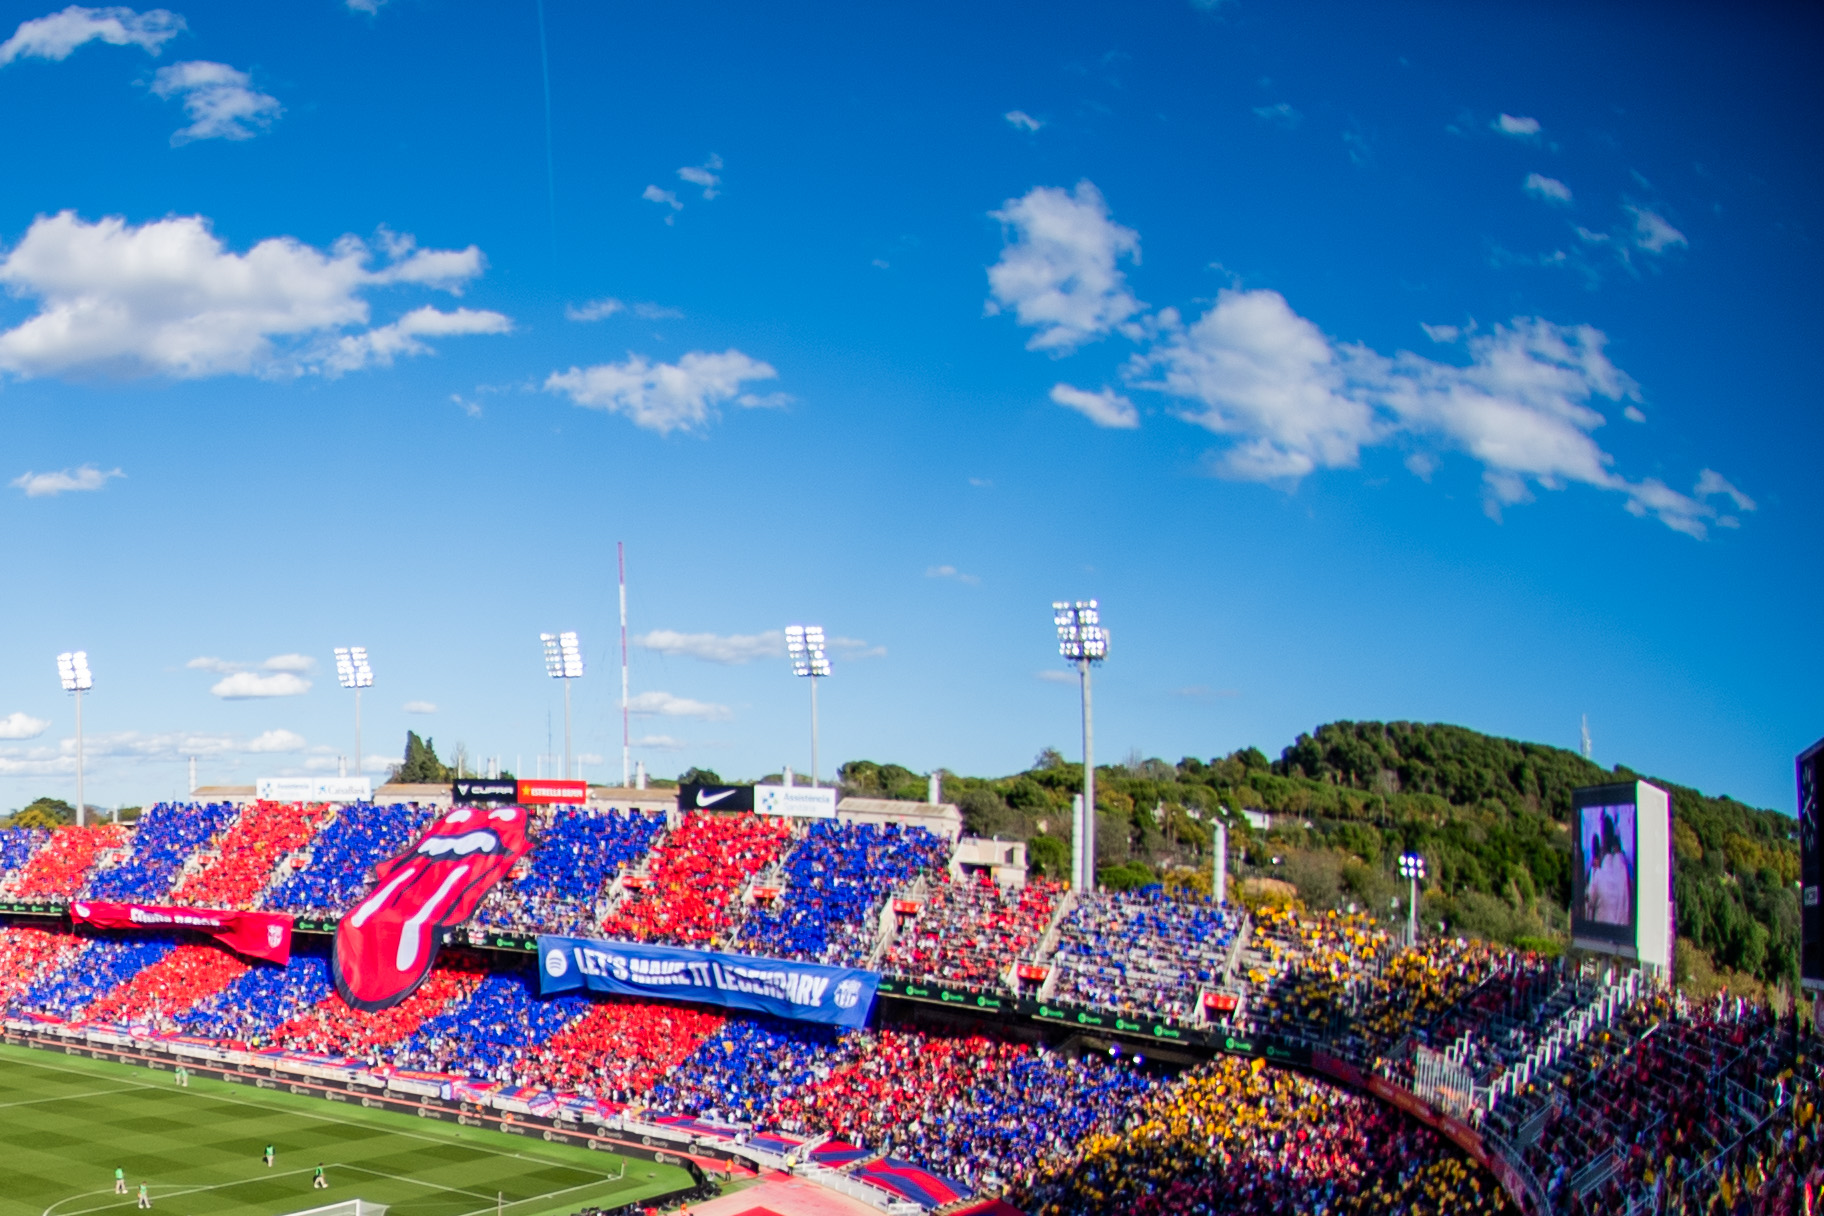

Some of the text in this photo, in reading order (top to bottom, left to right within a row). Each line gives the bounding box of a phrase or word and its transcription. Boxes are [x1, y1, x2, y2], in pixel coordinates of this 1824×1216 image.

[573, 947, 830, 1007] LET'S MAKE IT LEGENDARY
